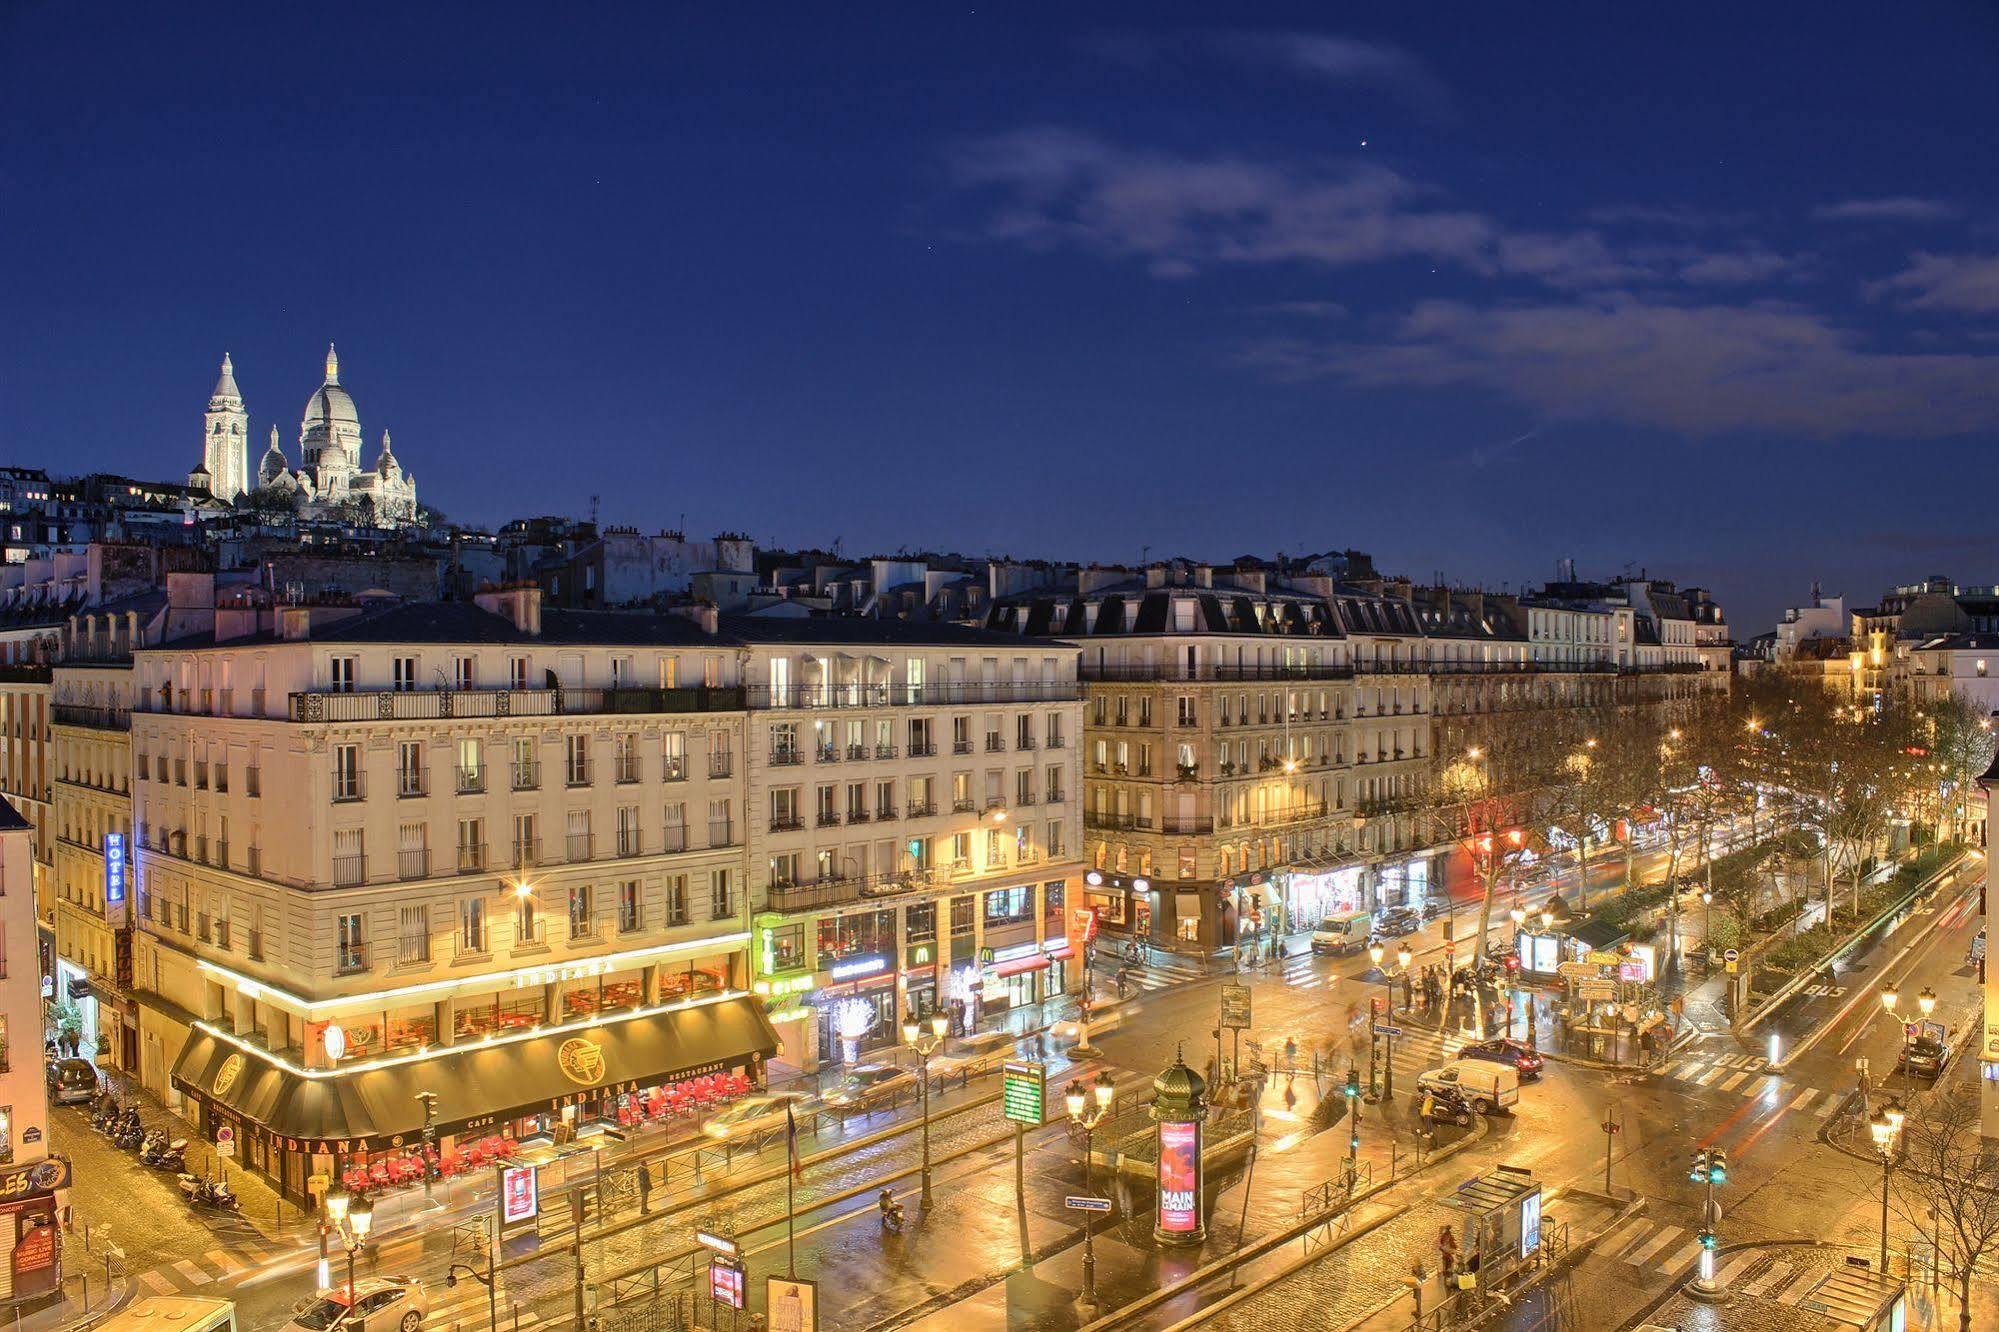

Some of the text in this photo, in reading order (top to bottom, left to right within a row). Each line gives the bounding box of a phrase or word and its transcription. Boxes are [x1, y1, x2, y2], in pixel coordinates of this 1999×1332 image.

[107, 834, 122, 900] HOTEL
[516, 962, 615, 989] INDIANA
[1803, 985, 1848, 997] BUS
[669, 1062, 725, 1081] RESTAURANT
[1712, 1053, 1768, 1071] BUS
[552, 1080, 639, 1111] INDIANA
[467, 1117, 495, 1129] CAFE
[270, 1133, 369, 1154] INDIANA
[1161, 1190, 1193, 1203] MAIN
